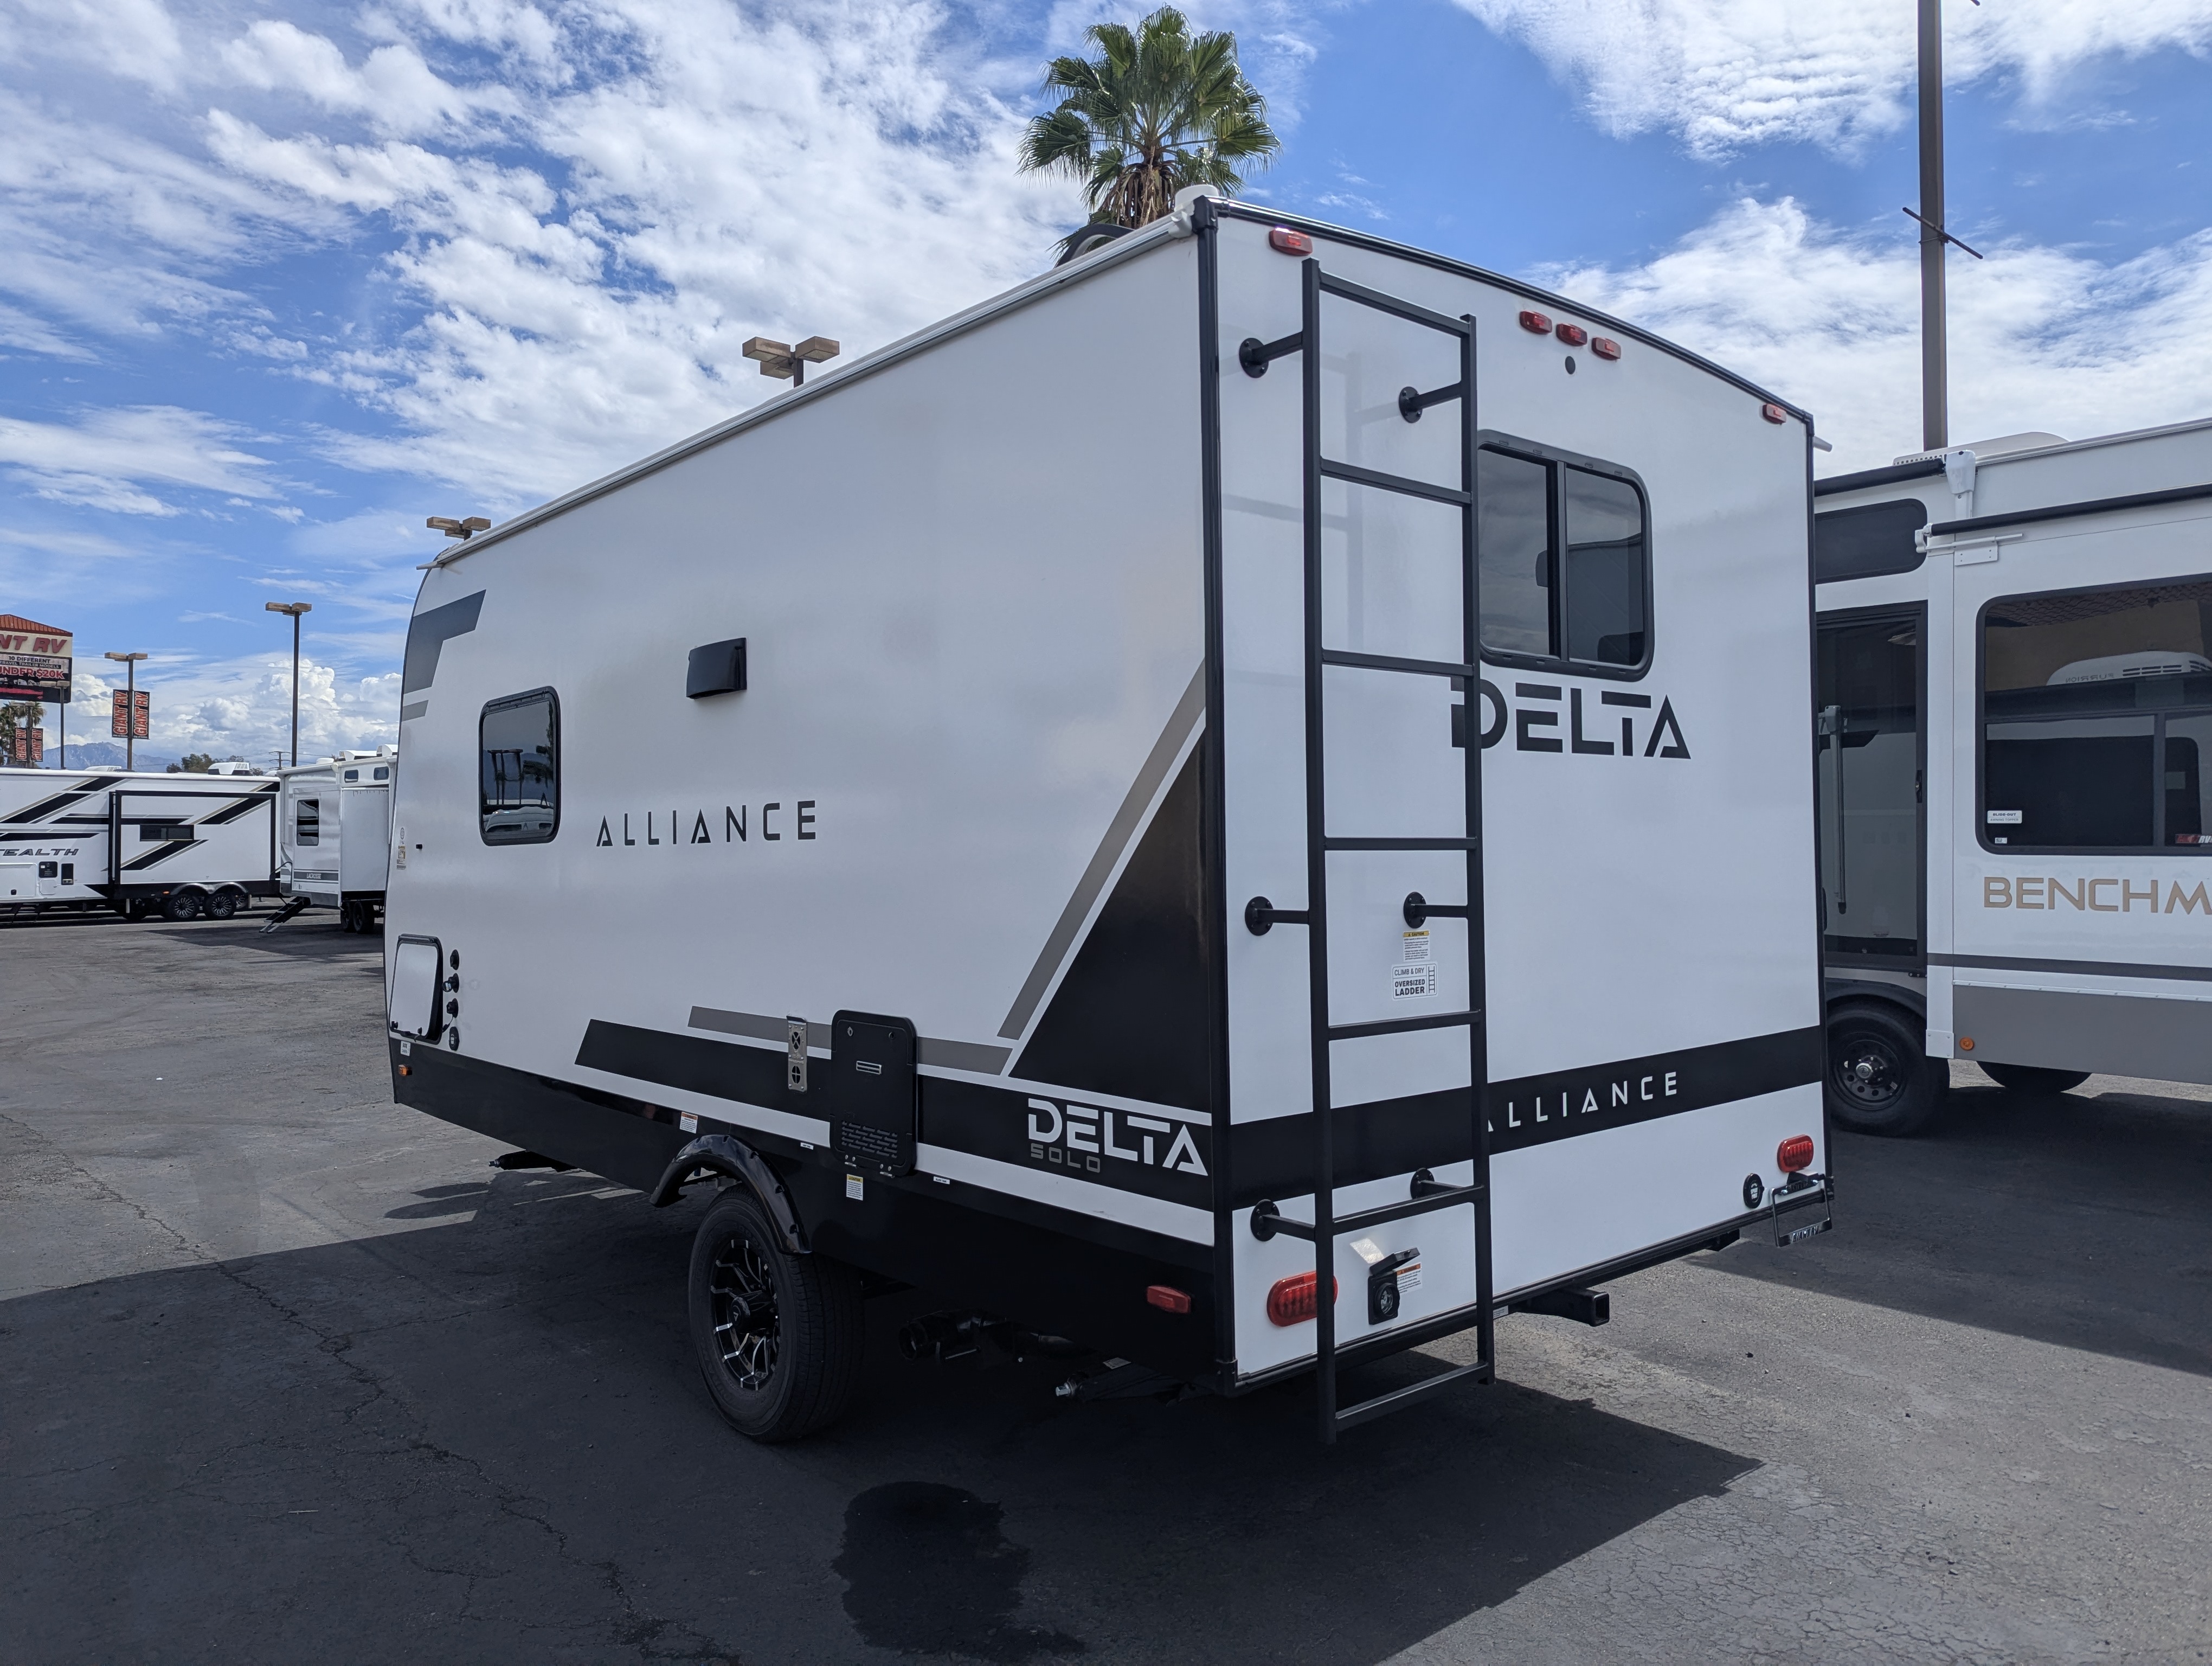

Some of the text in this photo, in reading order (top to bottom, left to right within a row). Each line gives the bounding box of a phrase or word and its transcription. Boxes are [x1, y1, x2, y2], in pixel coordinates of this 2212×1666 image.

[33, 637, 67, 653] RV
[36, 668, 65, 679] $20K
[114, 690, 128, 706] RV
[113, 705, 128, 735] GIANT
[133, 691, 149, 736] GIANT RV
[1450, 675, 1692, 760] DELTA
[15, 728, 27, 739] RV
[16, 738, 27, 759] GIANT
[31, 739, 42, 759] GIANT
[596, 800, 816, 847] ALLIANCE
[0, 848, 79, 856] EALTH
[1984, 876, 2212, 915] BENCHM
[1394, 978, 1425, 988] OVERSIZED
[1395, 986, 1425, 996] LADDER
[1488, 1071, 1677, 1132] LLIANCE
[1028, 1098, 1208, 1176] DELTA
[1031, 1143, 1101, 1173] SOLO
